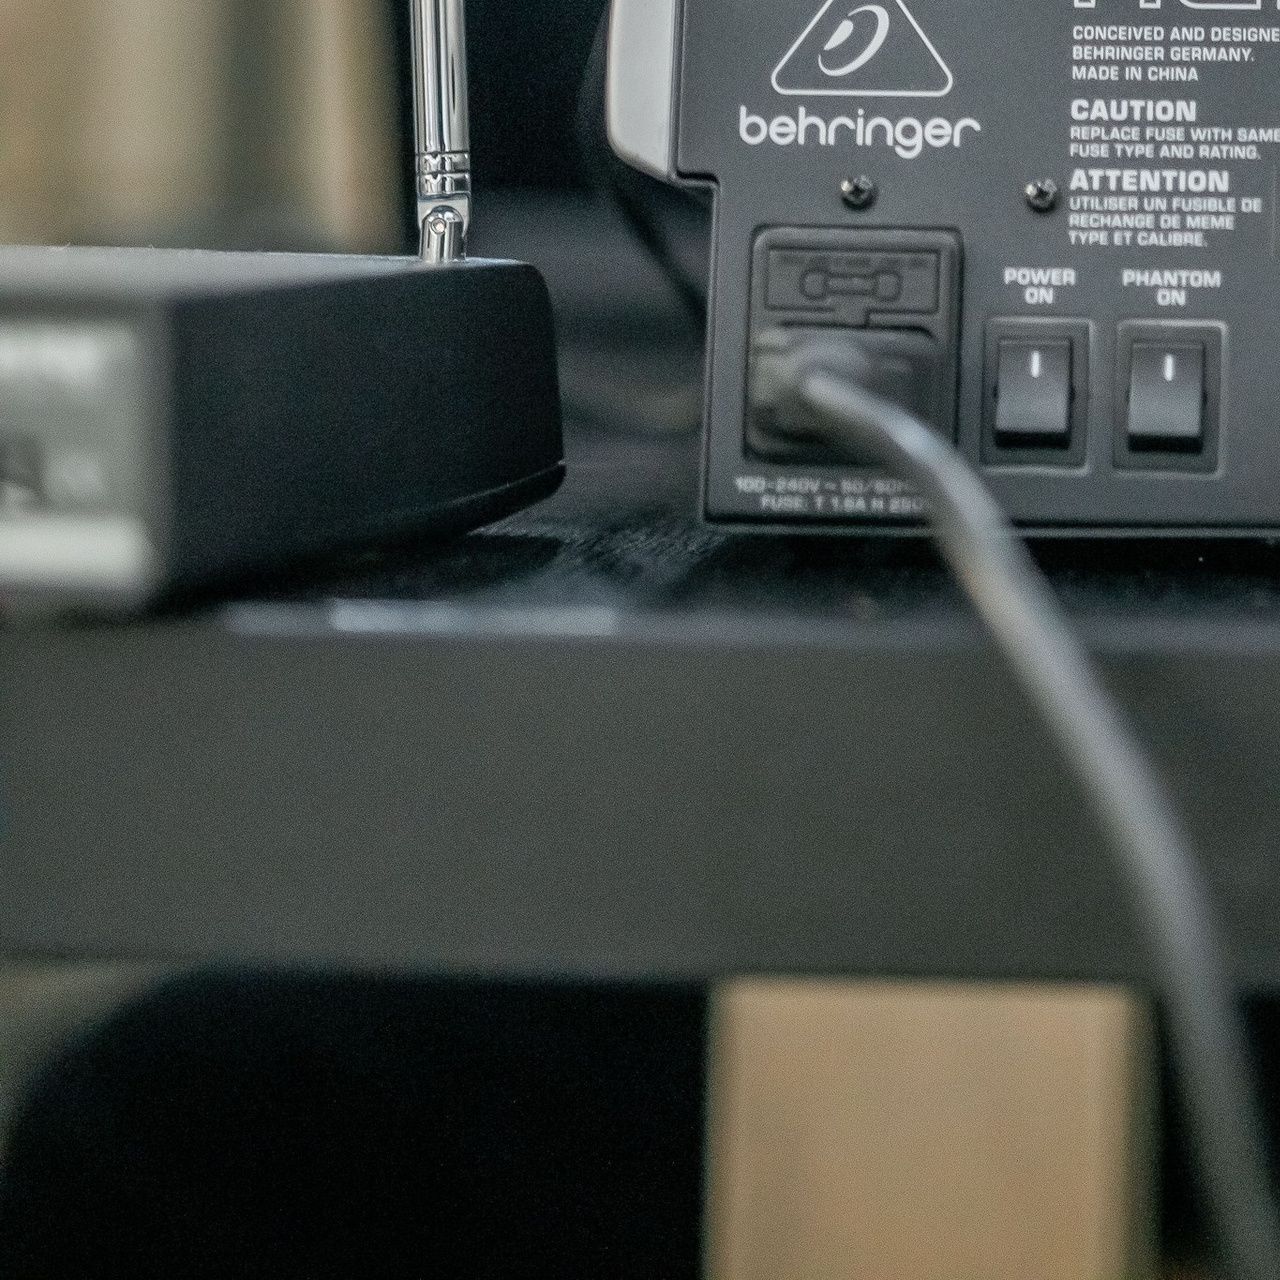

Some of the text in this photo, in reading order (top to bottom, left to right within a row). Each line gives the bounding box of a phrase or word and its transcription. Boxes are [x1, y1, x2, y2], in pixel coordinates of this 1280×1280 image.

[1072, 25, 1165, 41] CONCEIVED
[1170, 26, 1206, 41] AND
[1072, 45, 1255, 62] BEHRINGER GERMANY.
[1072, 65, 1199, 81] MADE IN CHINA
[1070, 98, 1197, 122] CAUTION
[738, 105, 982, 160] behringer
[1069, 125, 1141, 141] REPLACE
[1145, 126, 1185, 141] FUSE
[1190, 127, 1233, 142] WITH
[1069, 143, 1261, 160] FUSE TYPE AND RATING.
[1069, 168, 1230, 193] ATTENTION
[1069, 195, 1262, 213] UTILISER UN FUSIBLE DE
[1068, 213, 1235, 230] RECHANGE DE MEME
[1068, 230, 1109, 246] TYPE
[1113, 230, 1133, 246] ET
[1003, 266, 1077, 286] POWER
[1121, 268, 1222, 288] PHANTOM
[1023, 287, 1054, 304] ON
[1156, 289, 1187, 306] ON
